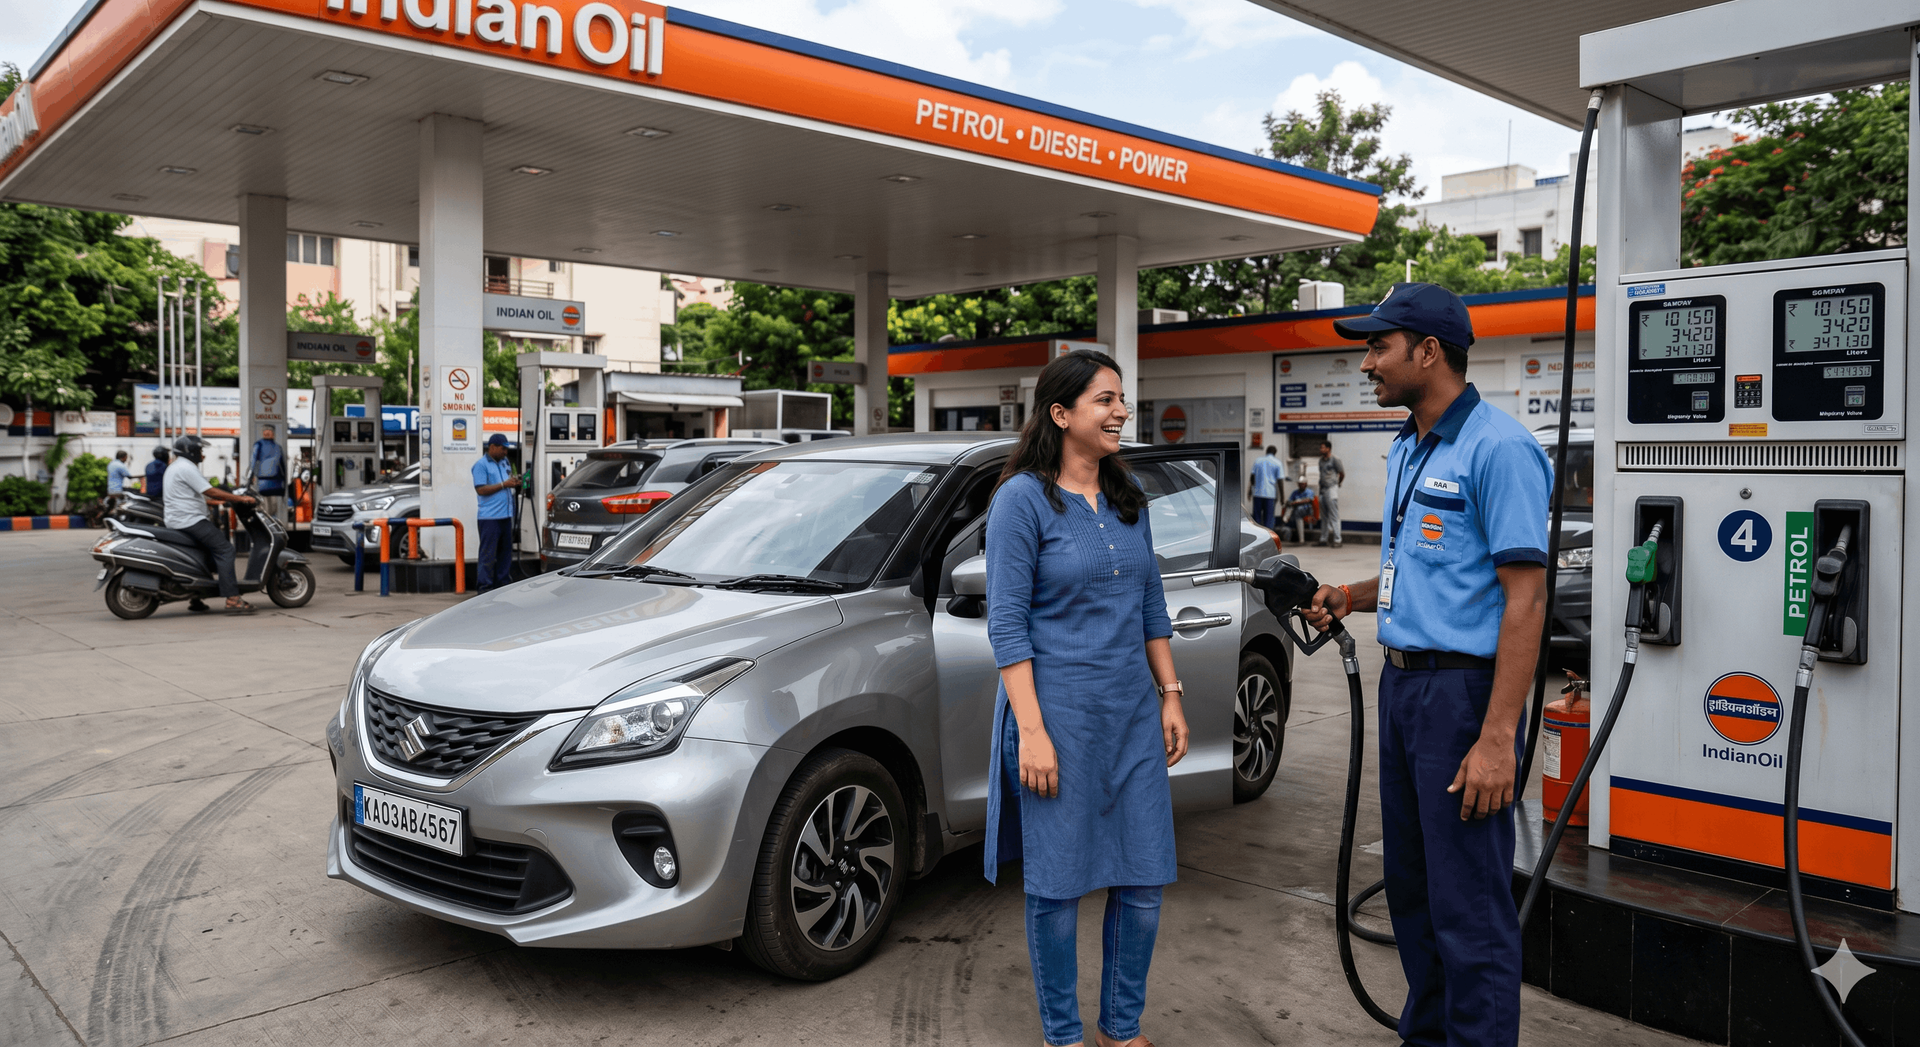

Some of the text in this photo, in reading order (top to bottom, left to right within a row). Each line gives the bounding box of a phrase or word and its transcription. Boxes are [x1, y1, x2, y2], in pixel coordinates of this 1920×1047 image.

[573, 2, 664, 76] Oil
[915, 98, 1189, 184] PETROL DIESEL POWER
[496, 307, 555, 321] INDIAN OIL
[1822, 316, 1870, 334] 34.20
[297, 341, 347, 352] INDIAN OIL
[1672, 326, 1713, 343] 34.20
[454, 392, 465, 401] NO
[1730, 519, 1758, 553] 4
[1788, 526, 1808, 619] PETROL
[1702, 743, 1783, 769] IndianOil
[364, 795, 458, 845] KA03AB4567
